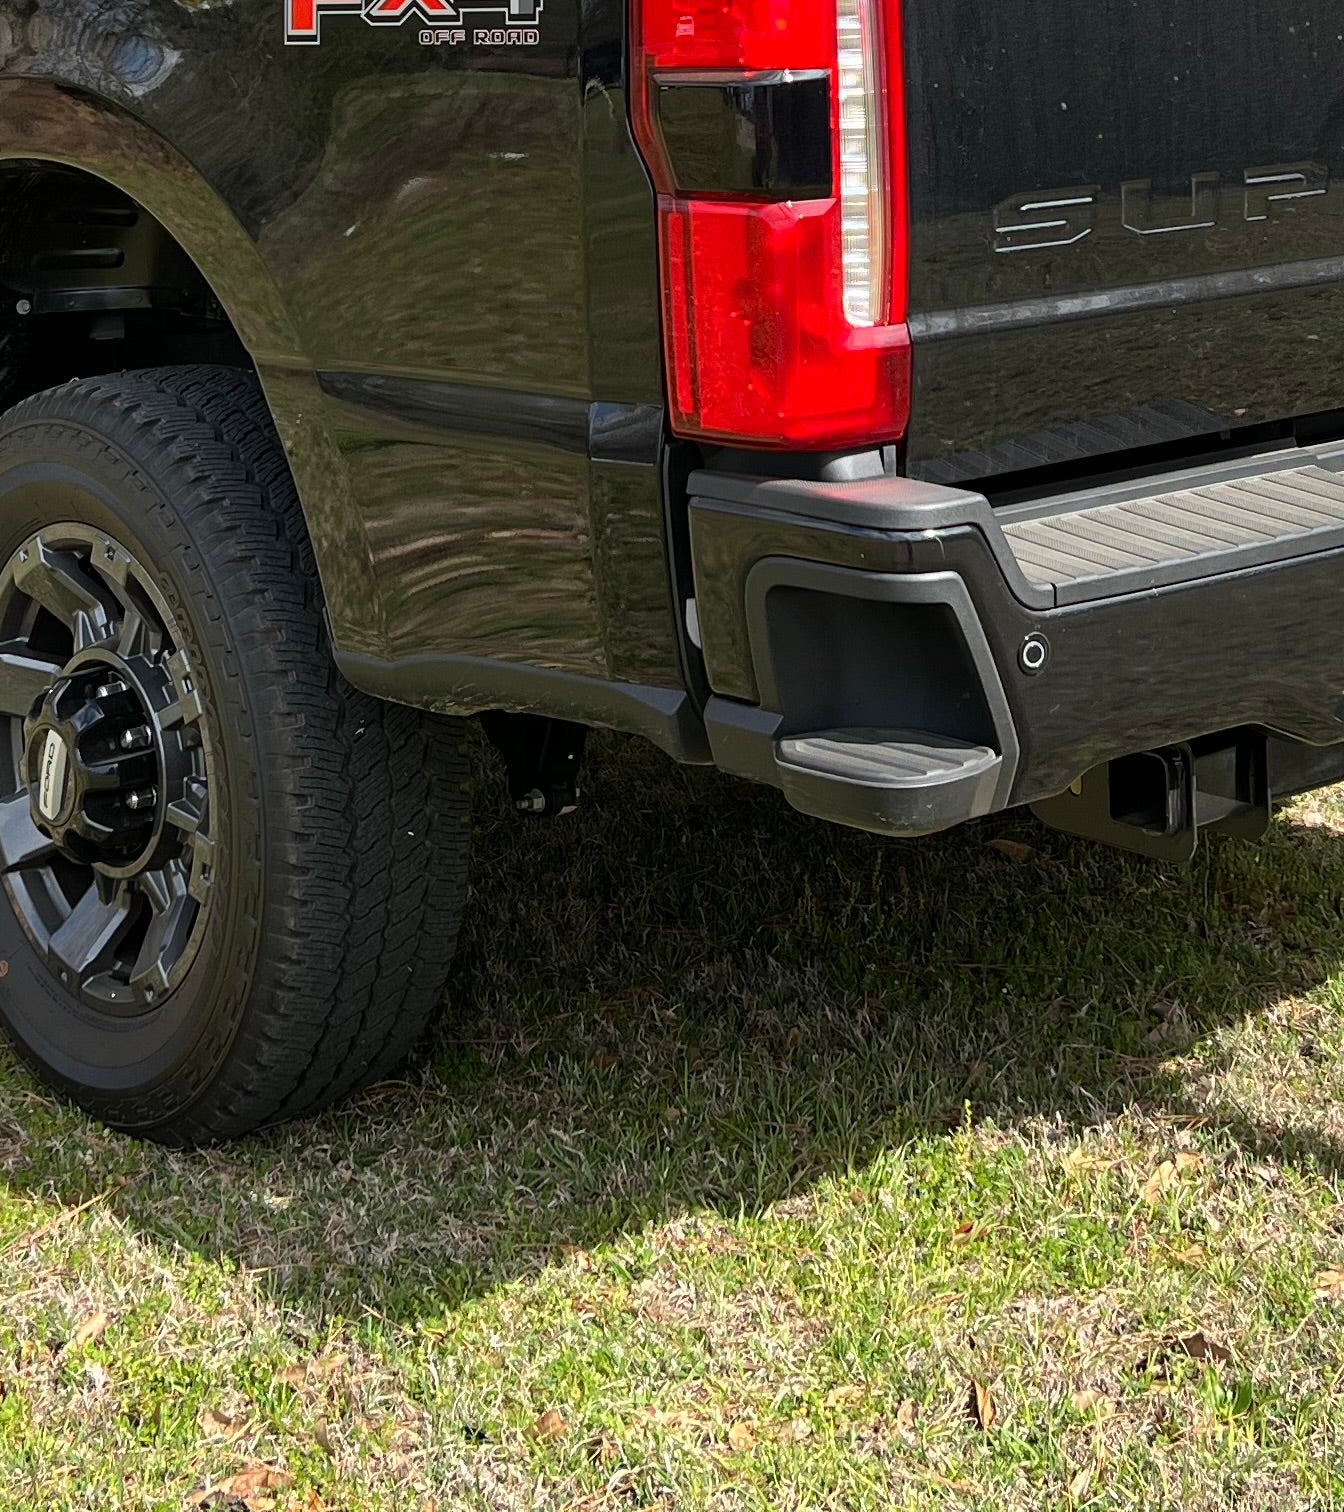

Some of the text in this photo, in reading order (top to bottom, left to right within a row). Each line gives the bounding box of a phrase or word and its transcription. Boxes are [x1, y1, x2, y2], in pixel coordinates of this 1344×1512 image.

[418, 28, 540, 46] OFF ROAD
[43, 742, 56, 809] FORD
